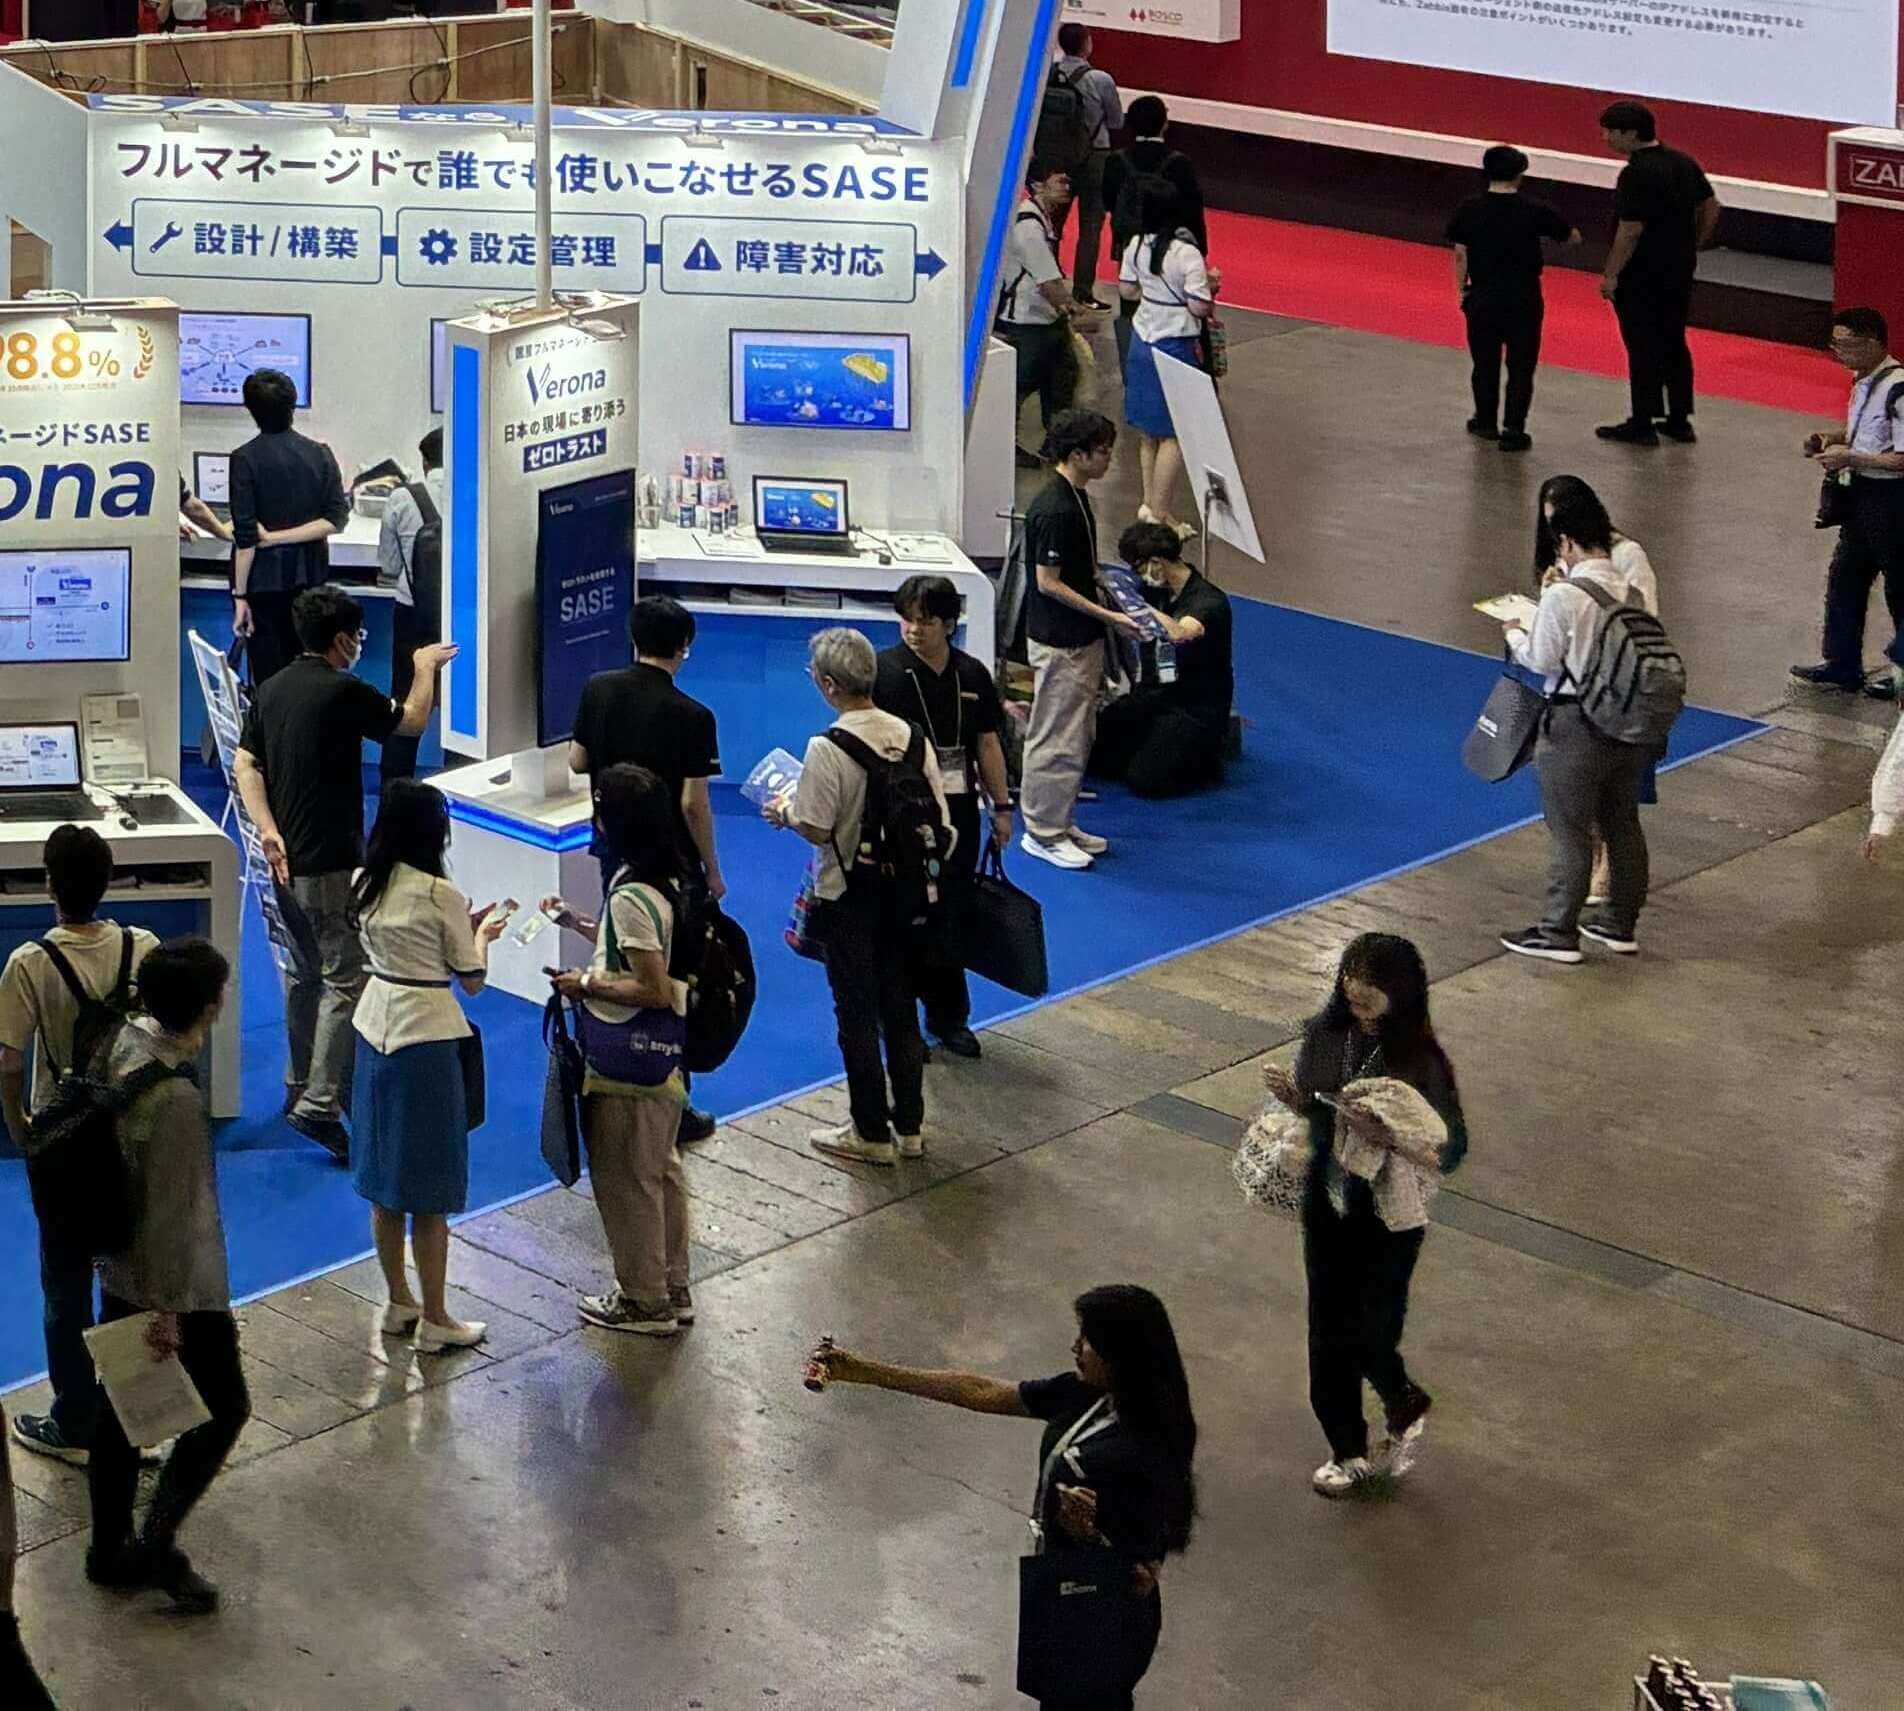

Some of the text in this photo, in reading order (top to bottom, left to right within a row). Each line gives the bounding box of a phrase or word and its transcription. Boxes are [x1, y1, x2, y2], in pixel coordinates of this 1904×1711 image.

[1854, 159, 1904, 187] ZA
[192, 221, 360, 261] 設計/構築
[471, 232, 618, 270] 設定管理
[735, 239, 886, 278] 障害対応
[526, 361, 608, 407] Verona
[502, 398, 626, 444] 日本の現場に寄り添う
[526, 434, 605, 470] ゼロトラスト
[559, 586, 616, 624] SASE
